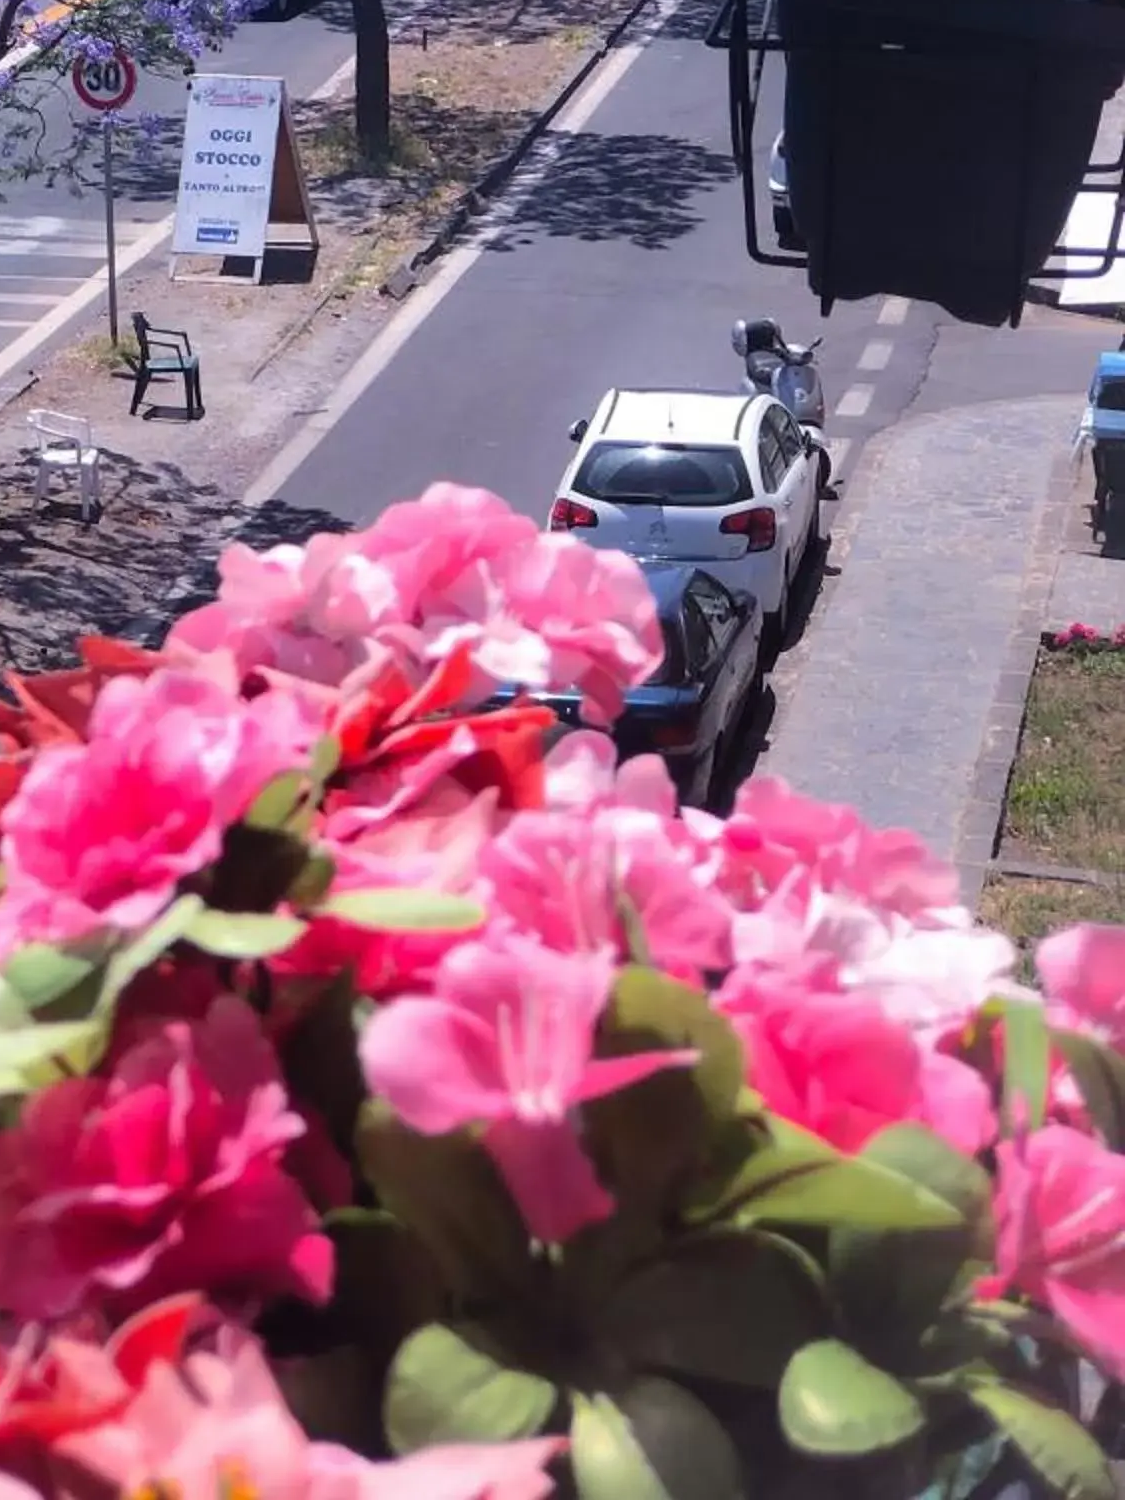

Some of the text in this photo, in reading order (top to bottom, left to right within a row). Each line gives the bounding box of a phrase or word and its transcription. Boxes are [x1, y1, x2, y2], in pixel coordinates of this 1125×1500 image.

[86, 61, 121, 91] 30
[210, 129, 252, 143] OGGI
[195, 151, 262, 167] STOCCO
